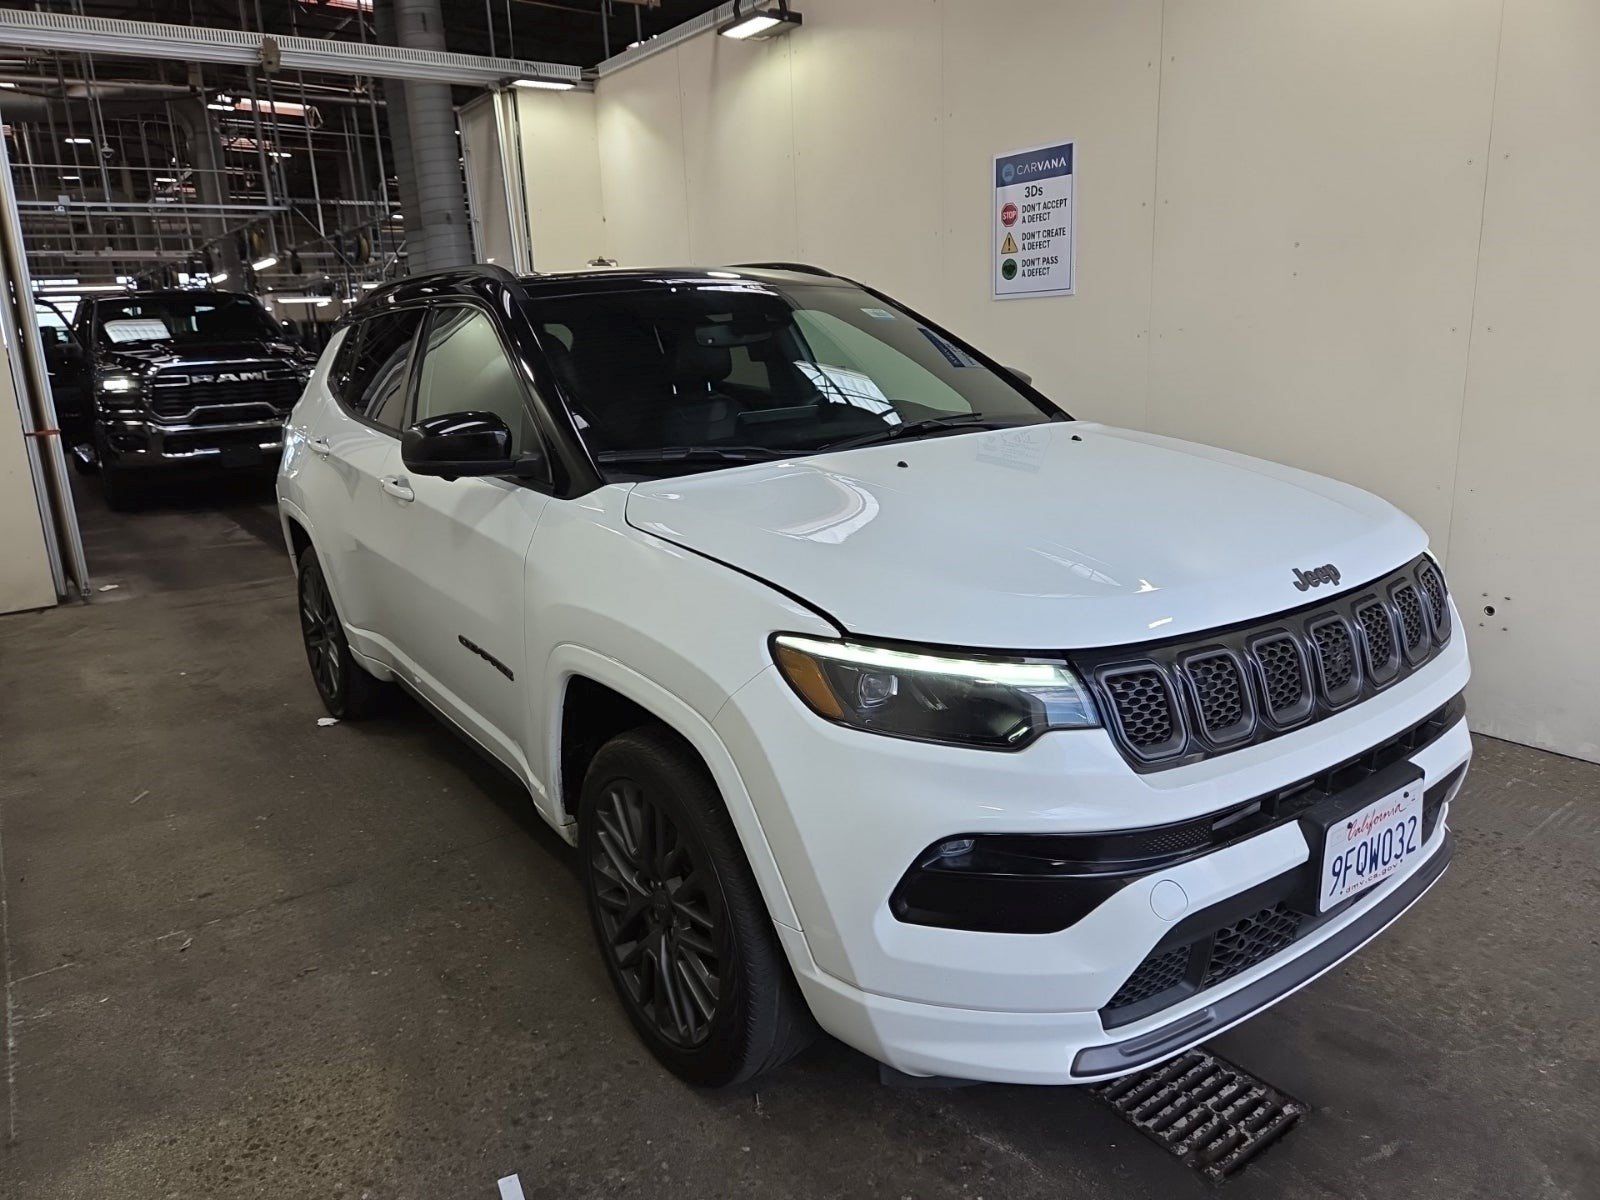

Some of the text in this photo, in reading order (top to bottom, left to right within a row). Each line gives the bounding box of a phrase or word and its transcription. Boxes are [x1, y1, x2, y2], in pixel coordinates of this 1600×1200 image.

[1016, 156, 1067, 176] CARVANA
[1024, 185, 1043, 198] 3Ds
[1022, 198, 1067, 213] DON'T ACCEPT
[1002, 210, 1017, 220] STOP
[1022, 212, 1051, 224] A DEFECT
[1022, 227, 1066, 241] DON'T CREATE
[1022, 240, 1051, 251] A DEFECT
[1022, 256, 1058, 268] DON'T PASS
[1022, 267, 1050, 277] A DEFECT
[191, 372, 262, 384] RAM
[1291, 564, 1341, 592] Jeep
[1347, 802, 1406, 841] California
[1329, 815, 1417, 897] 9FQW032
[1345, 863, 1398, 893] dmv.ca.gov
